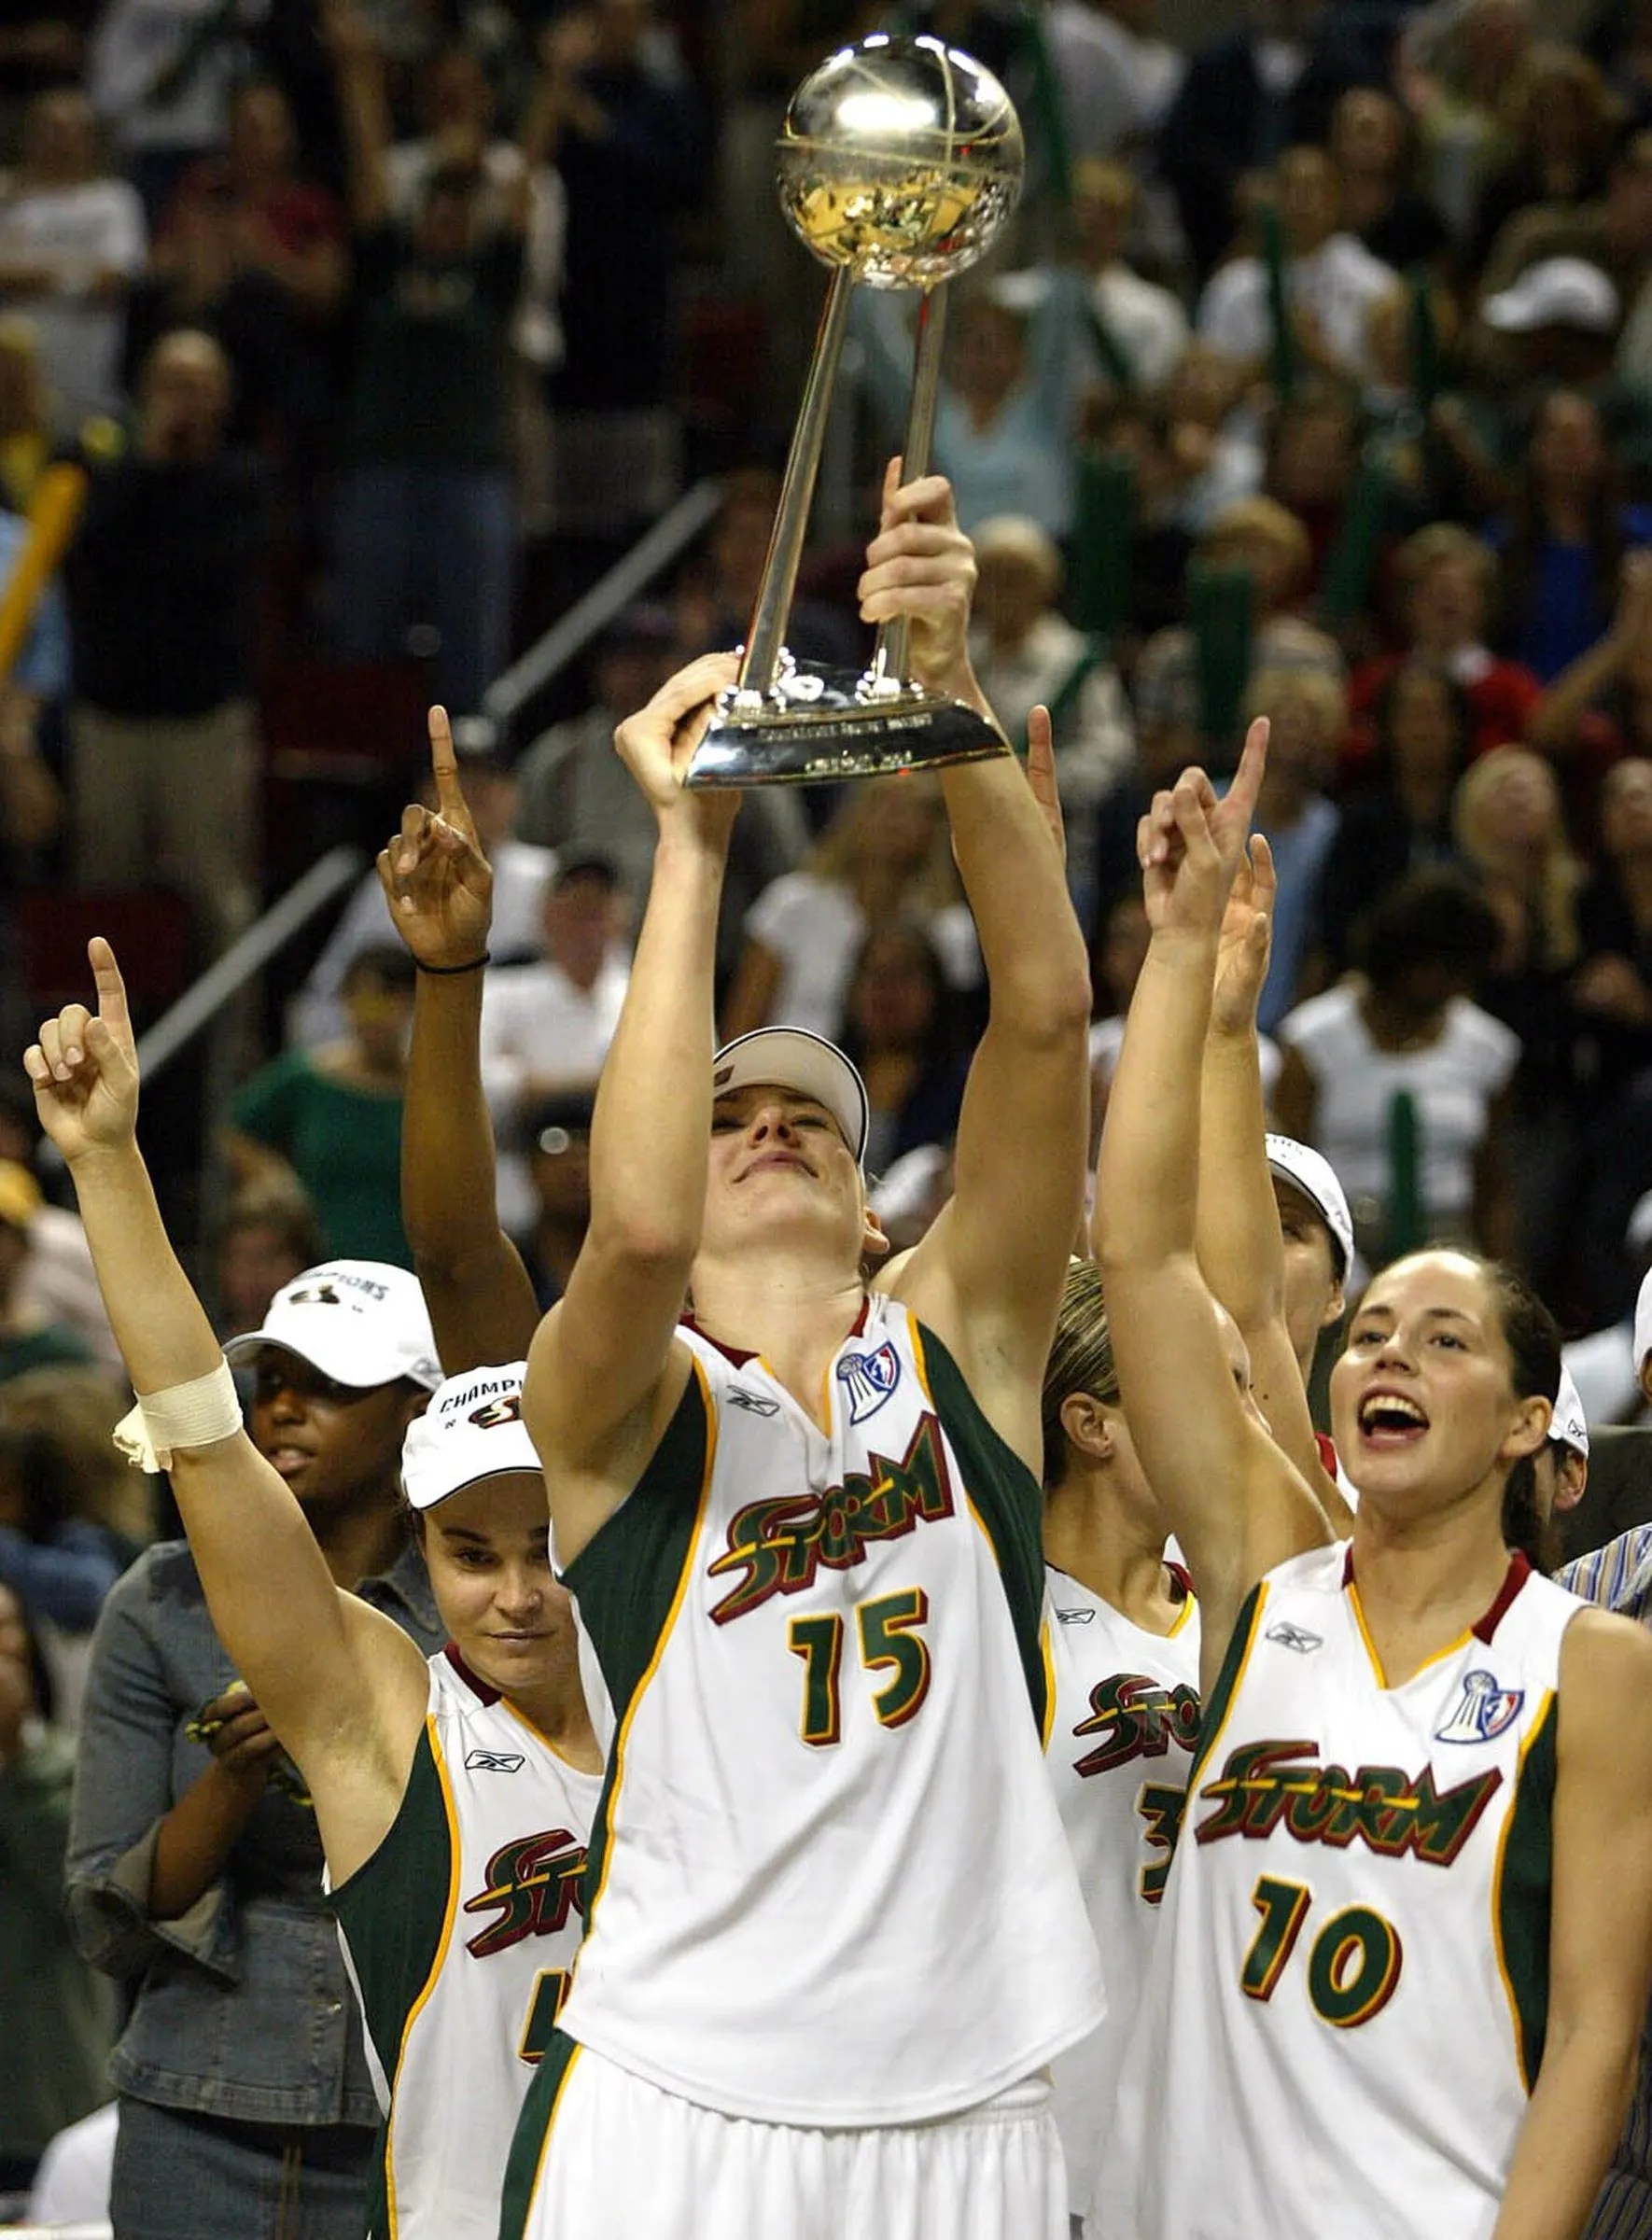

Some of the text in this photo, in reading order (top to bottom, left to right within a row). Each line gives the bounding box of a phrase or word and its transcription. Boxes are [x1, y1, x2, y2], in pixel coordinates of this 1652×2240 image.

[707, 1410, 954, 1626] STORM
[786, 1585, 932, 1748] 15
[1195, 1740, 1503, 1868] STORM
[1241, 1872, 1403, 2029] 10
